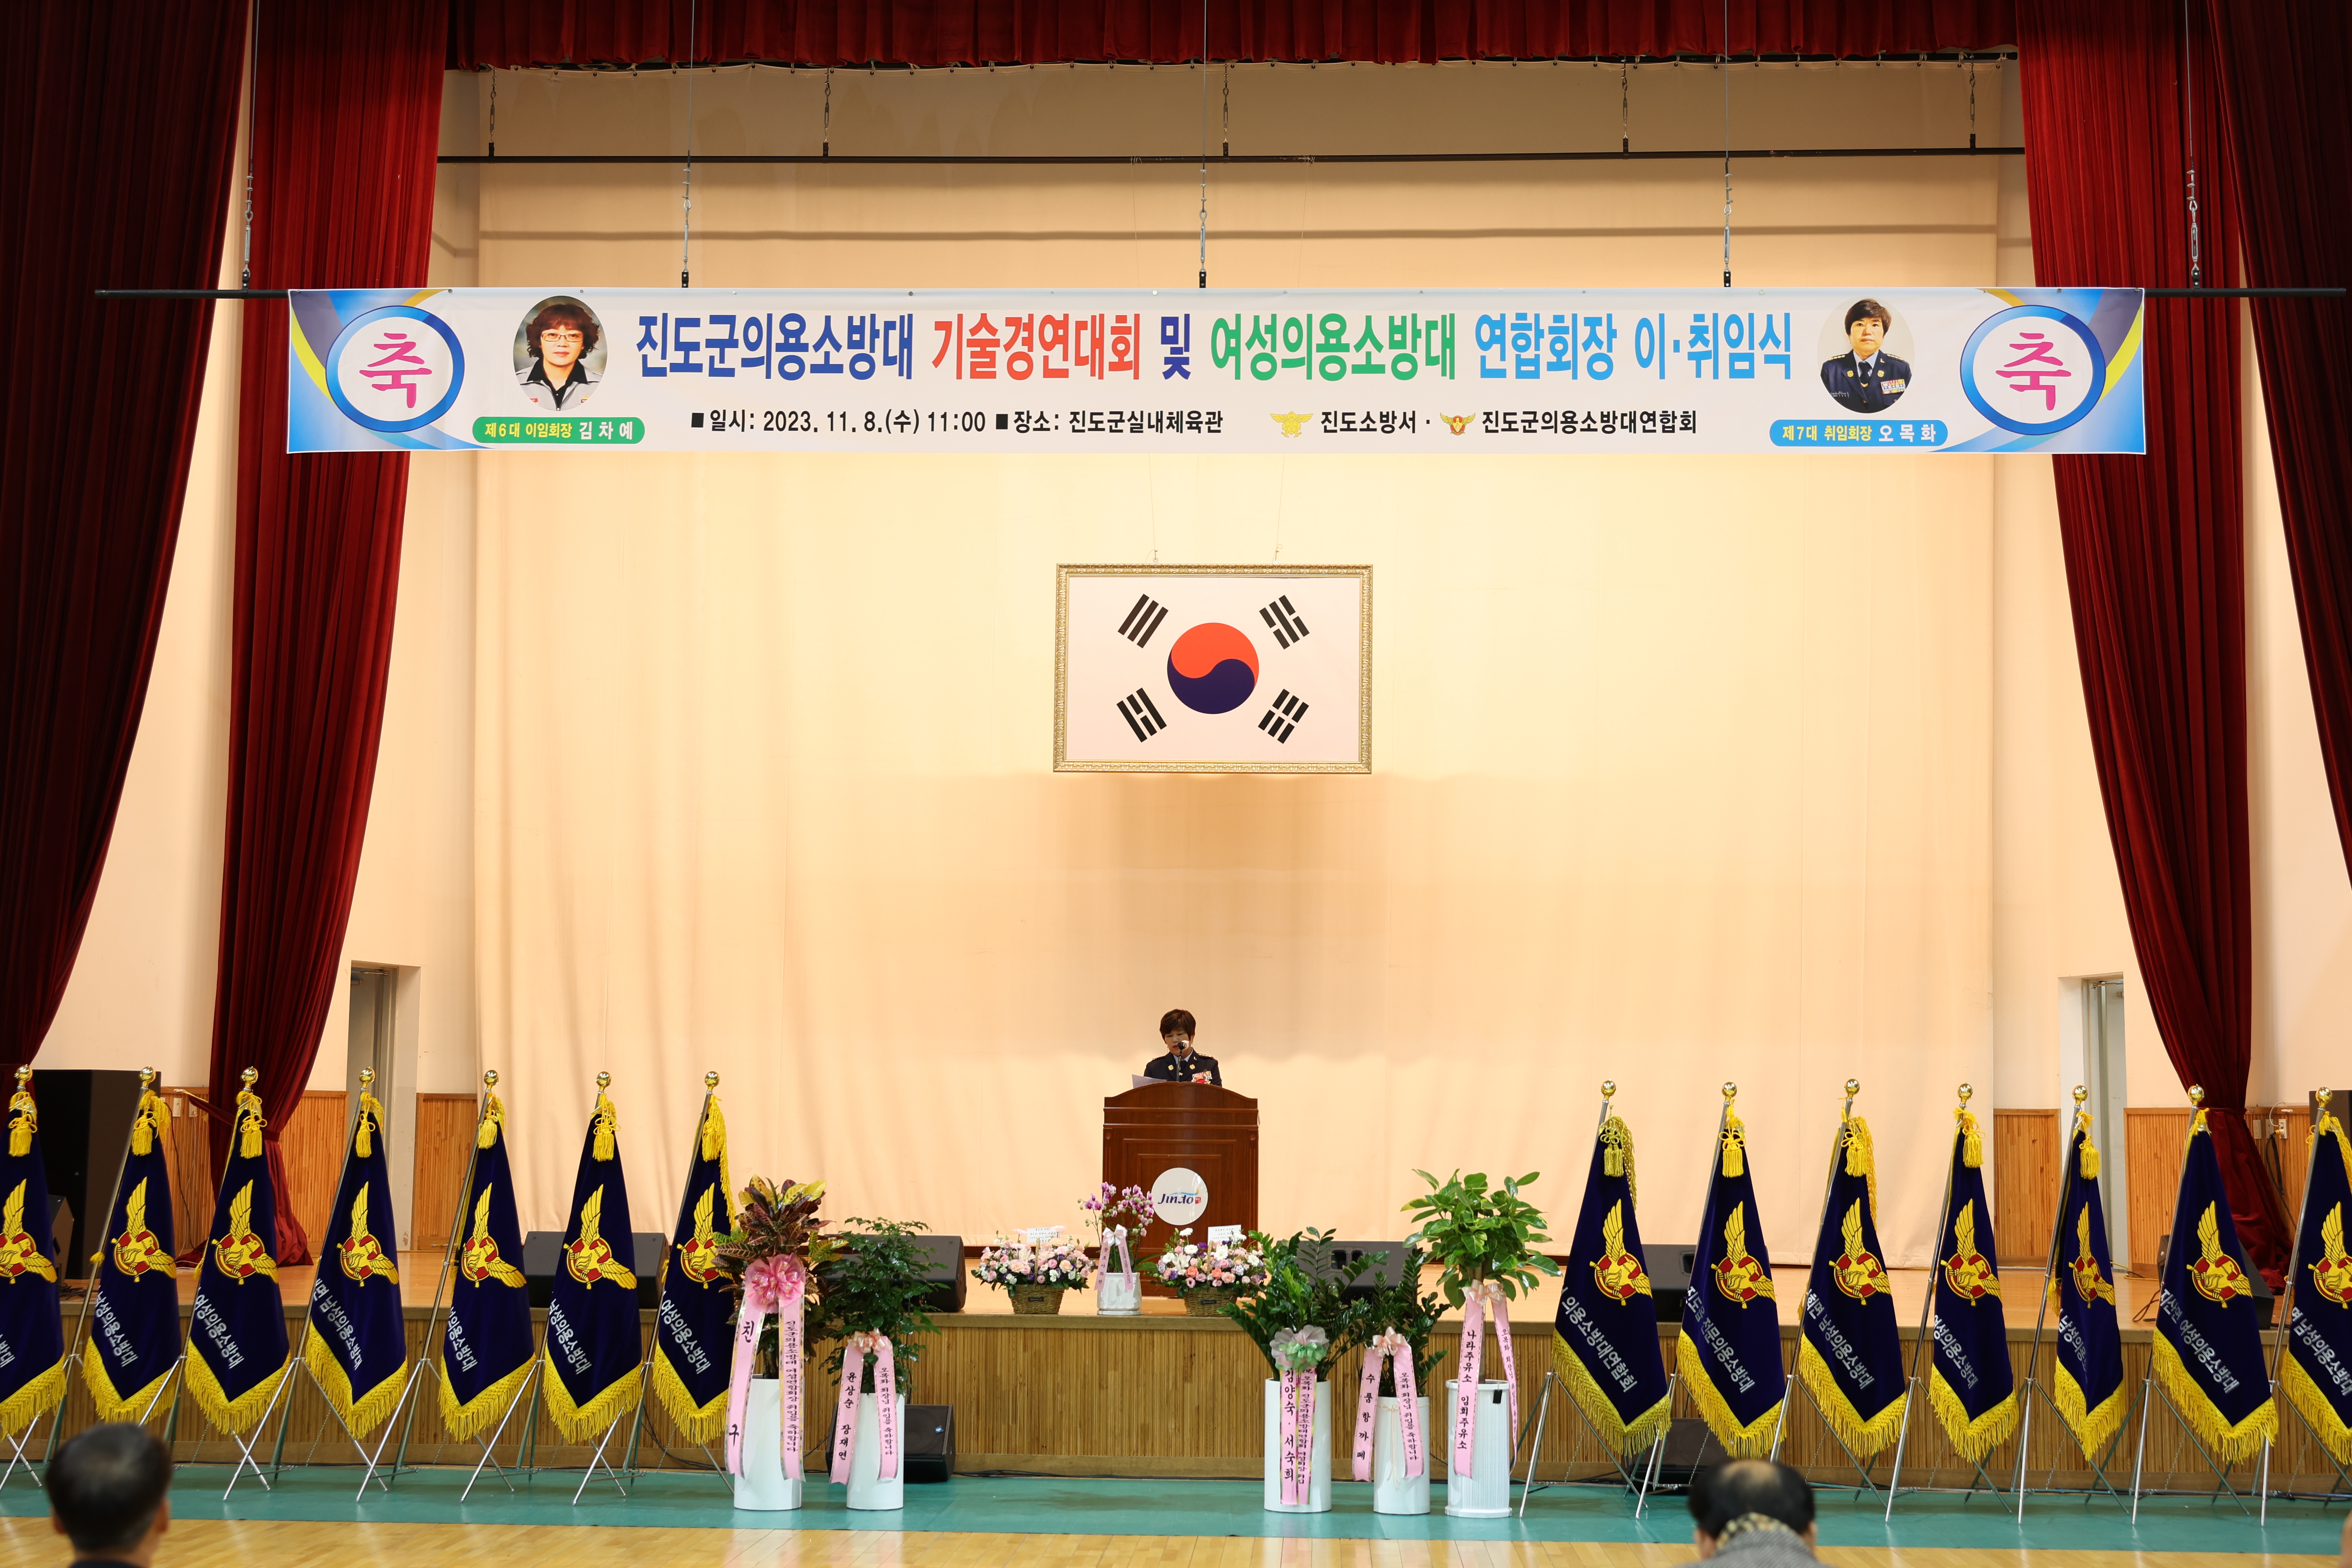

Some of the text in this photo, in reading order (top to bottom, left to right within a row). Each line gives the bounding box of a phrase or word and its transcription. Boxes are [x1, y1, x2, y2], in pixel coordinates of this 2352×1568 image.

[359, 332, 432, 408] 축
[636, 312, 913, 381] 진도군의용소방대
[932, 313, 1140, 380] 기술경연대회
[1161, 313, 1191, 380] 및
[1211, 313, 1455, 381] 여성의용소방대
[1475, 312, 1617, 380] 연합회장
[1995, 332, 2072, 411] 축
[485, 423, 520, 438] 제6대
[525, 422, 572, 438] 이임회장
[710, 409, 755, 432] 일시:
[763, 411, 818, 432] 2023.
[928, 411, 985, 432] 11:00
[1013, 410, 1059, 434] 장소:
[1069, 410, 1223, 434] 진도군실내체육관
[1320, 410, 1697, 434] 진도소방서 진도군의용소방대연합회
[1782, 425, 1817, 441] 제7대
[1824, 425, 1872, 441] 취임회장
[195, 1294, 245, 1369] 여성의용소방대
[319, 1295, 363, 1370] 남성의용소방대
[661, 1299, 711, 1374] 여성의용소방대
[1501, 1329, 1510, 1351] 오목화
[1561, 1296, 1638, 1393] 의용소방대연합회
[1701, 1317, 1755, 1394] 전문의용소방대
[1806, 1288, 1875, 1390] 회면 남성의용소방대
[2160, 1289, 2240, 1394] 지산면 여성의용소방대
[784, 1320, 800, 1452] 진도군의용소방대 여성연합회장 취임을 축하합니다
[878, 1367, 894, 1455] 오목화 회장님 취임을 축하합니다
[1399, 1372, 1419, 1461] 오목화 회장님 취임을 축하합니다
[1457, 1329, 1477, 1449] 나라주유소 임회주유소
[838, 1424, 851, 1460] 장재연
[1284, 1434, 1296, 1483] 서숙희
